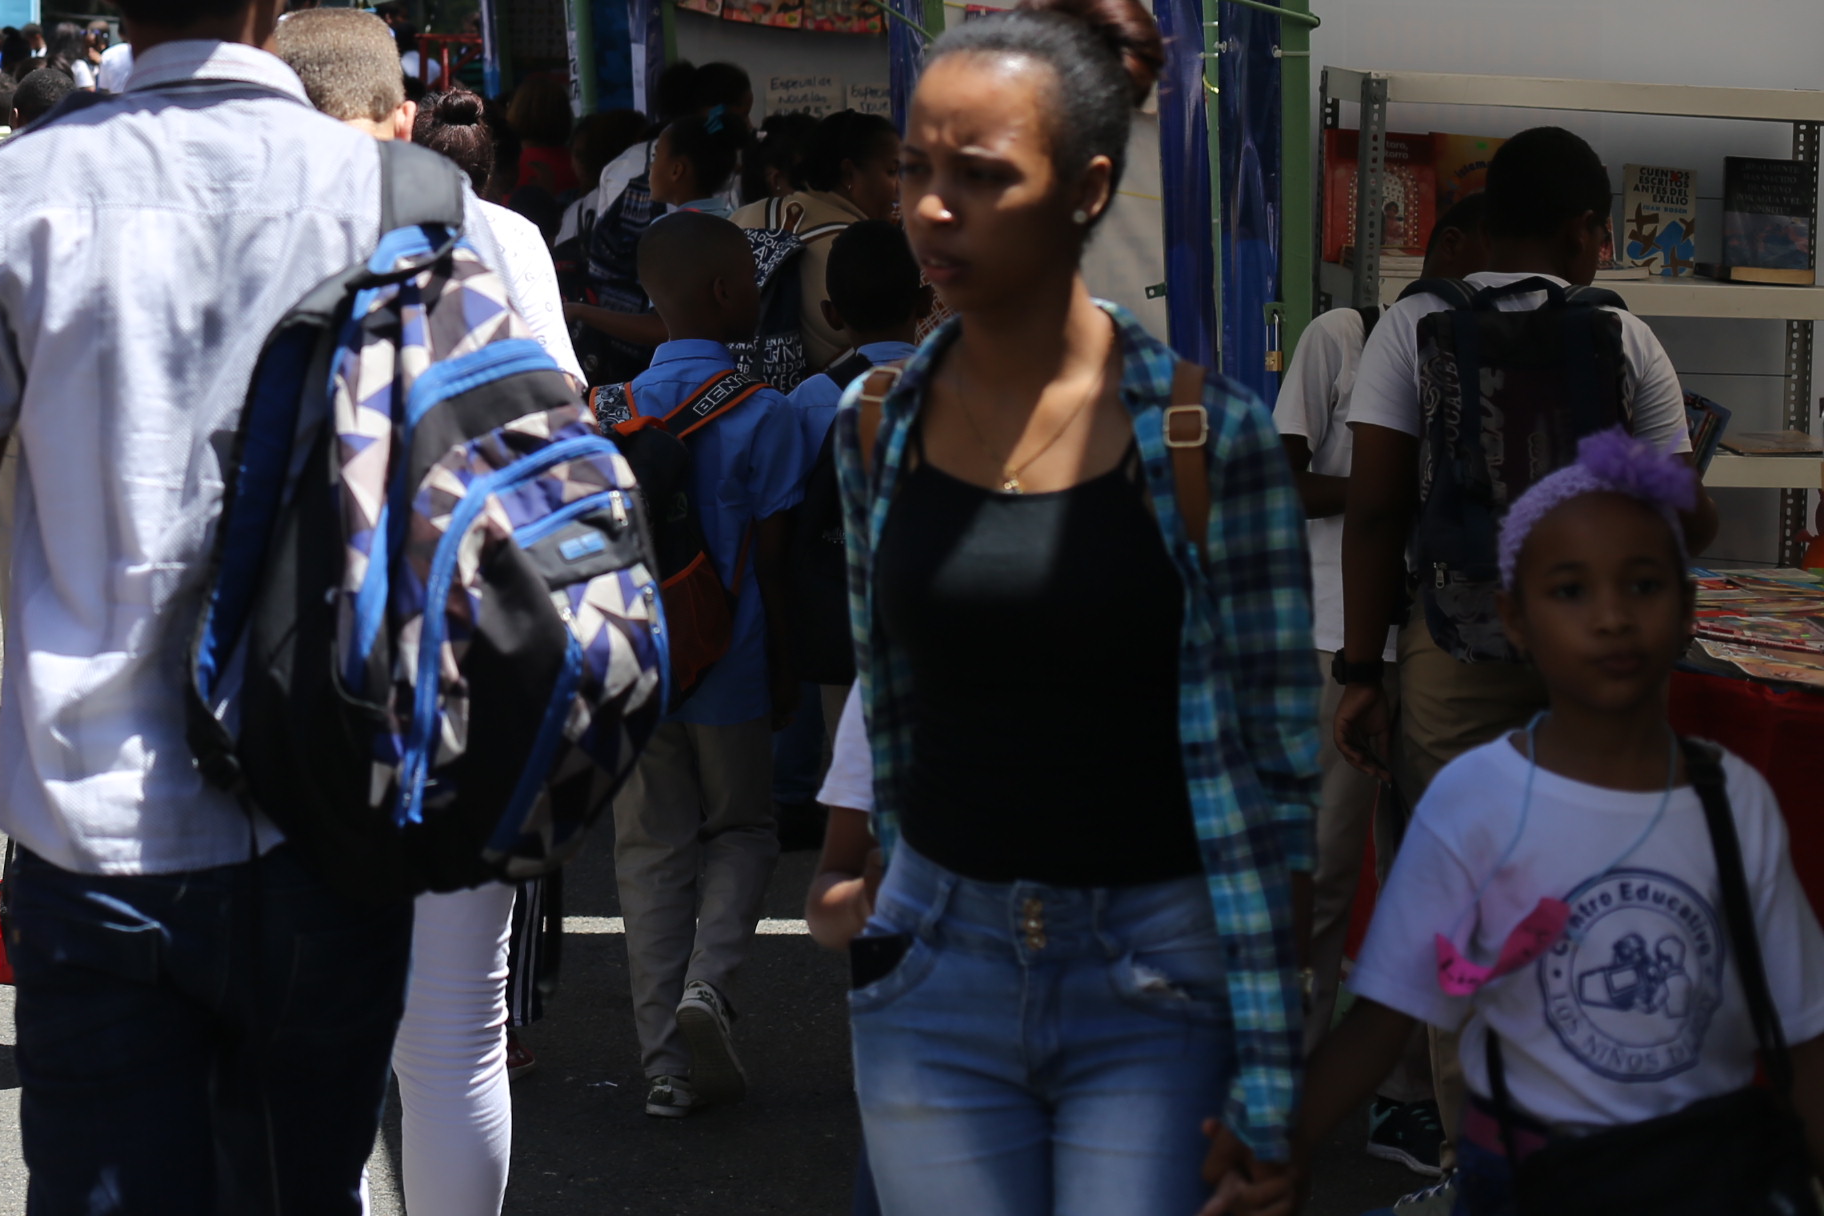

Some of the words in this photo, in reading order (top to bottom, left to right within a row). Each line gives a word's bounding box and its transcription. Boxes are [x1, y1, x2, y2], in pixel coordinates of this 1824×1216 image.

[1633, 183, 1667, 195] ANTES
[1669, 187, 1689, 198] DEL
[1652, 194, 1688, 206] EXILIO
[1551, 890, 1614, 957] Cntro
[1617, 880, 1713, 958] Educativo
